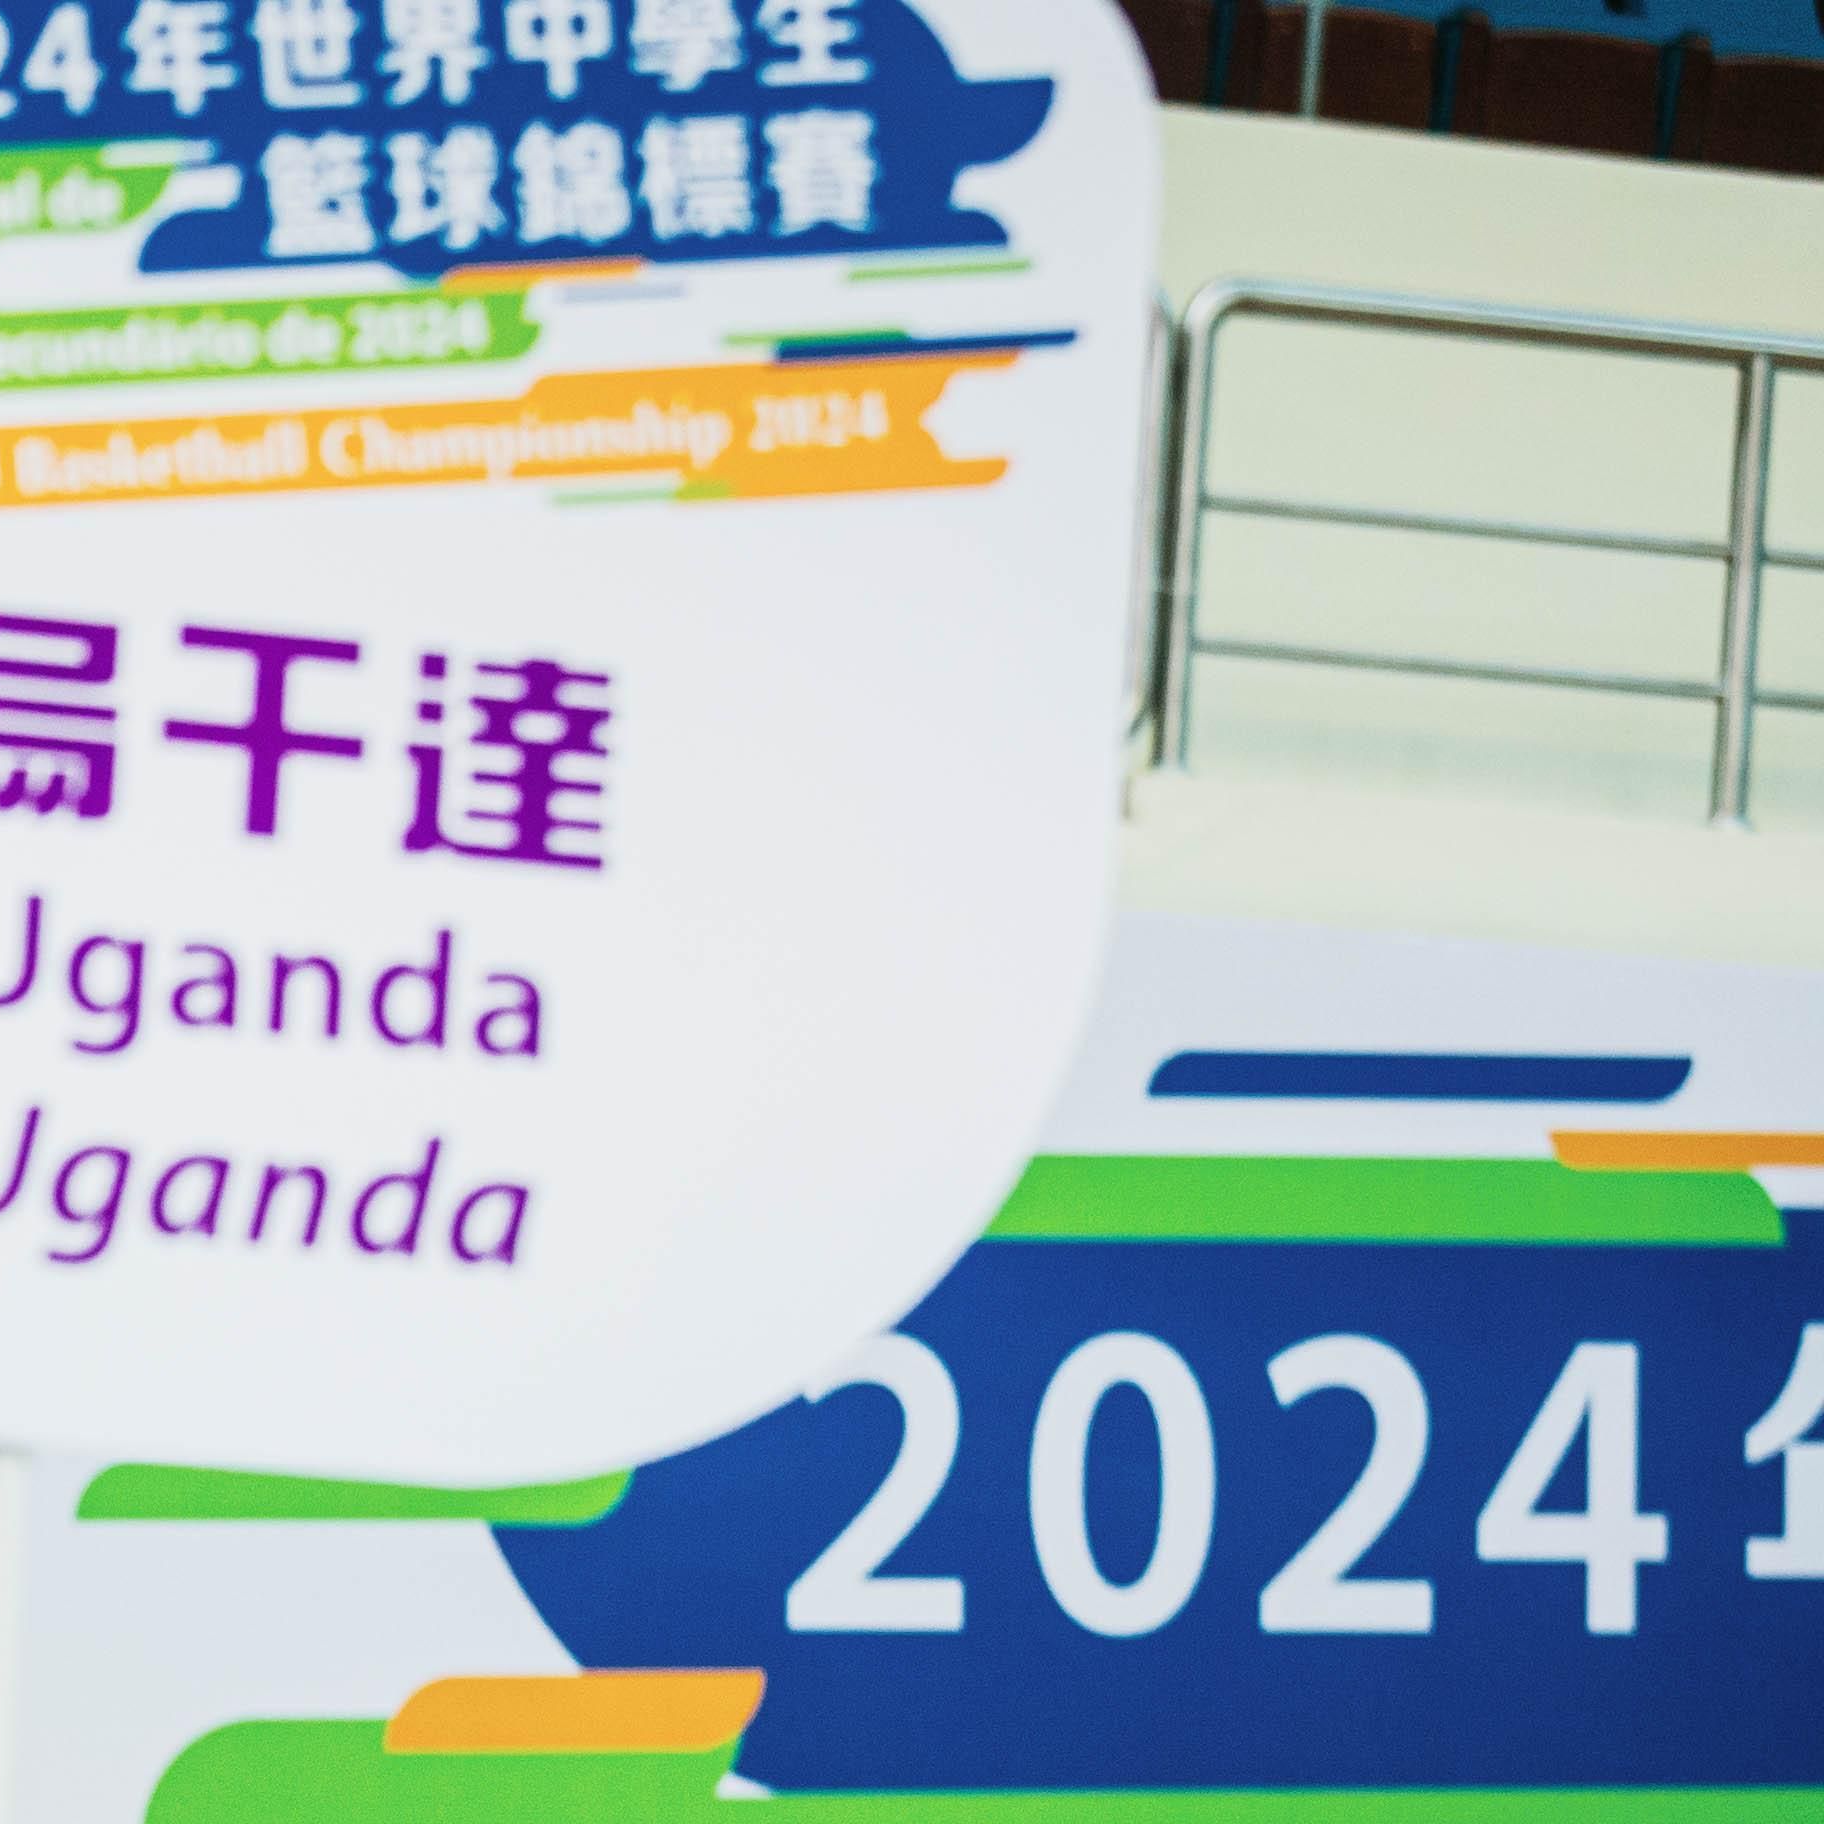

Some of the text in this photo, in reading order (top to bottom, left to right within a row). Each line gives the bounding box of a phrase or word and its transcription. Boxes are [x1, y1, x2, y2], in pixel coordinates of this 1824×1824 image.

[48, 167, 125, 228] de
[262, 107, 880, 257] 籃球錦標賽
[266, 304, 344, 364] de
[349, 299, 490, 361] 2024
[13, 420, 308, 498] Basketball
[318, 396, 732, 481] Championship
[750, 390, 889, 452] 2024
